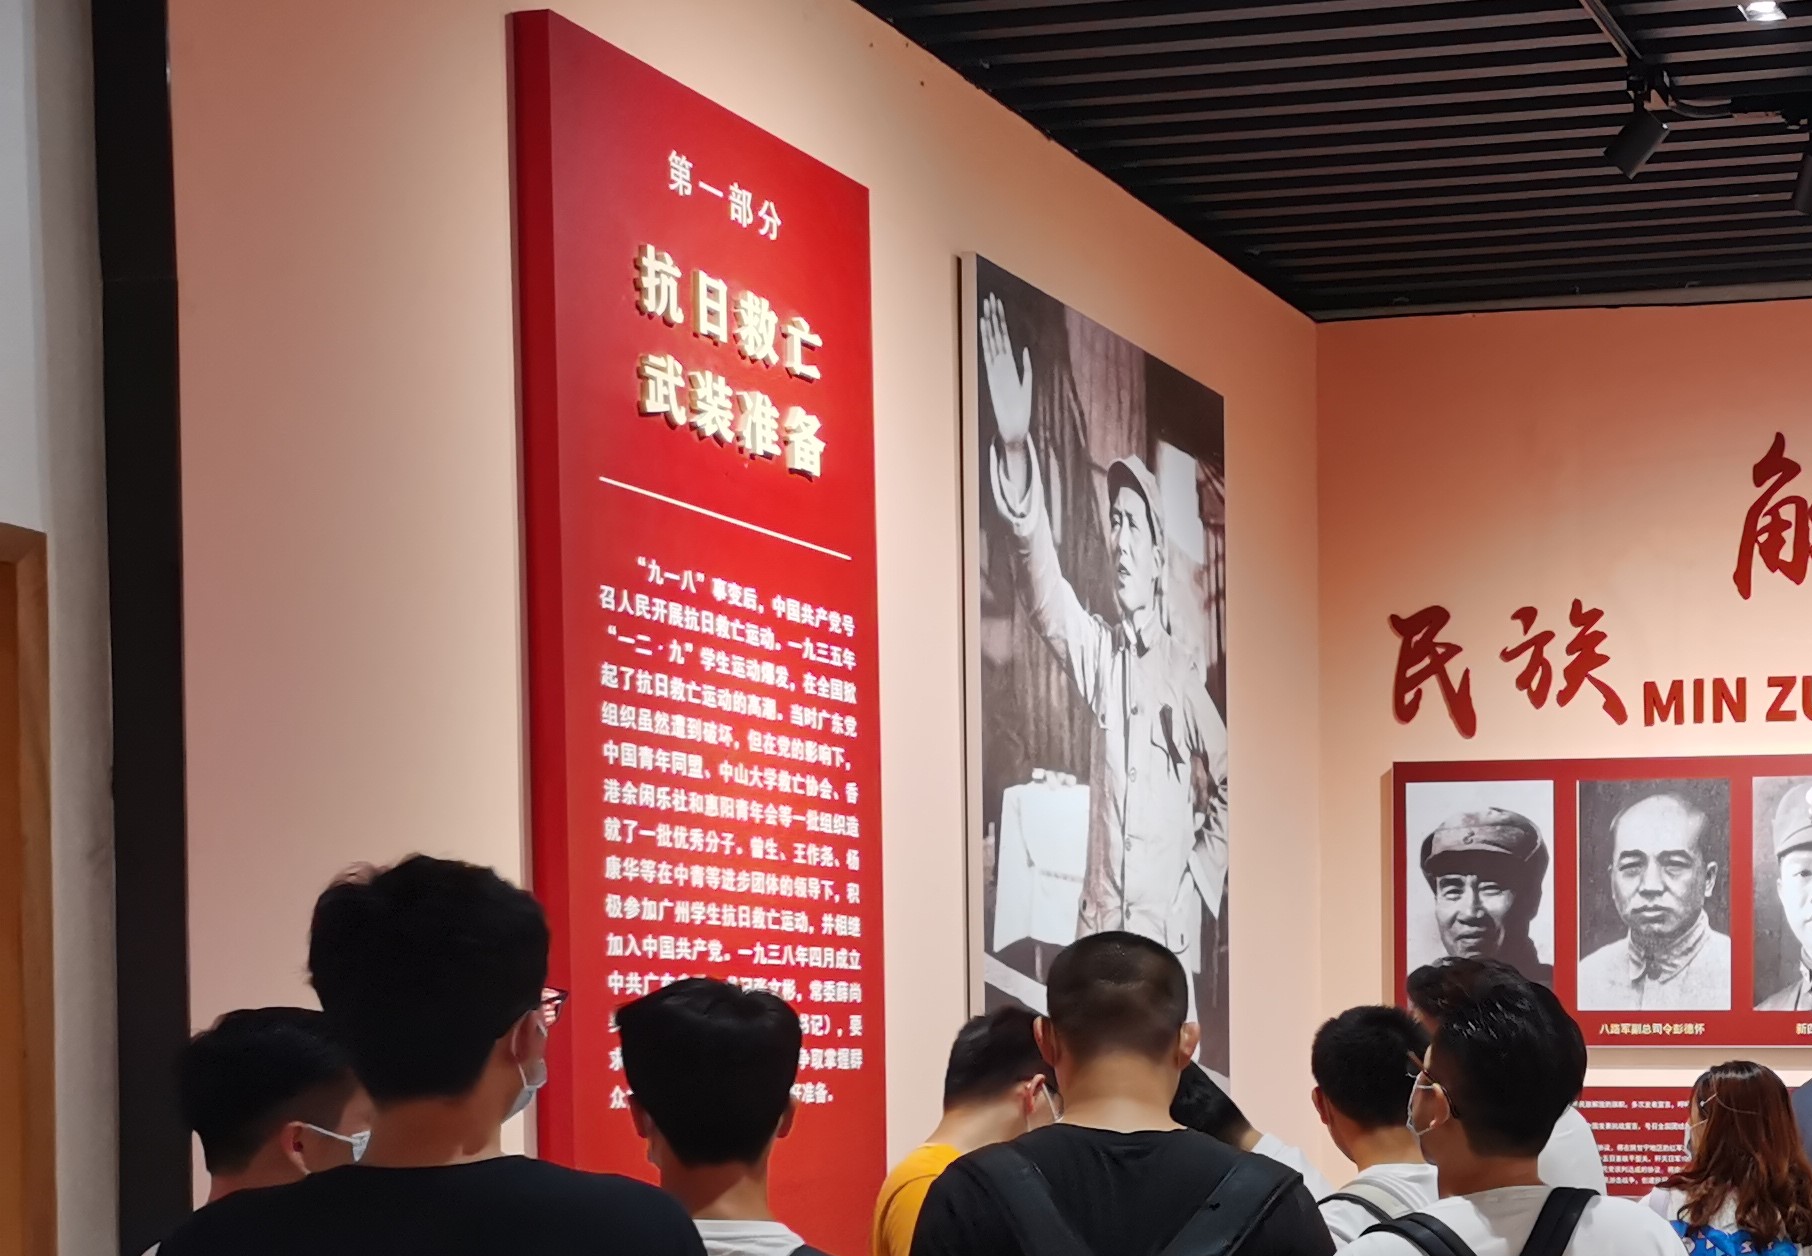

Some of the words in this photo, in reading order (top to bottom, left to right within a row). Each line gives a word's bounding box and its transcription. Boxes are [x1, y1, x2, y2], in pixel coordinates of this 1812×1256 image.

[668, 150, 782, 240] 第一部分
[635, 243, 823, 381] 抗日救亡
[637, 353, 826, 479] 武装准备
[1389, 598, 1628, 739] 民族
[1643, 677, 1747, 727] MIN
[1599, 1022, 1706, 1036] 八路军副总司令彭德怀
